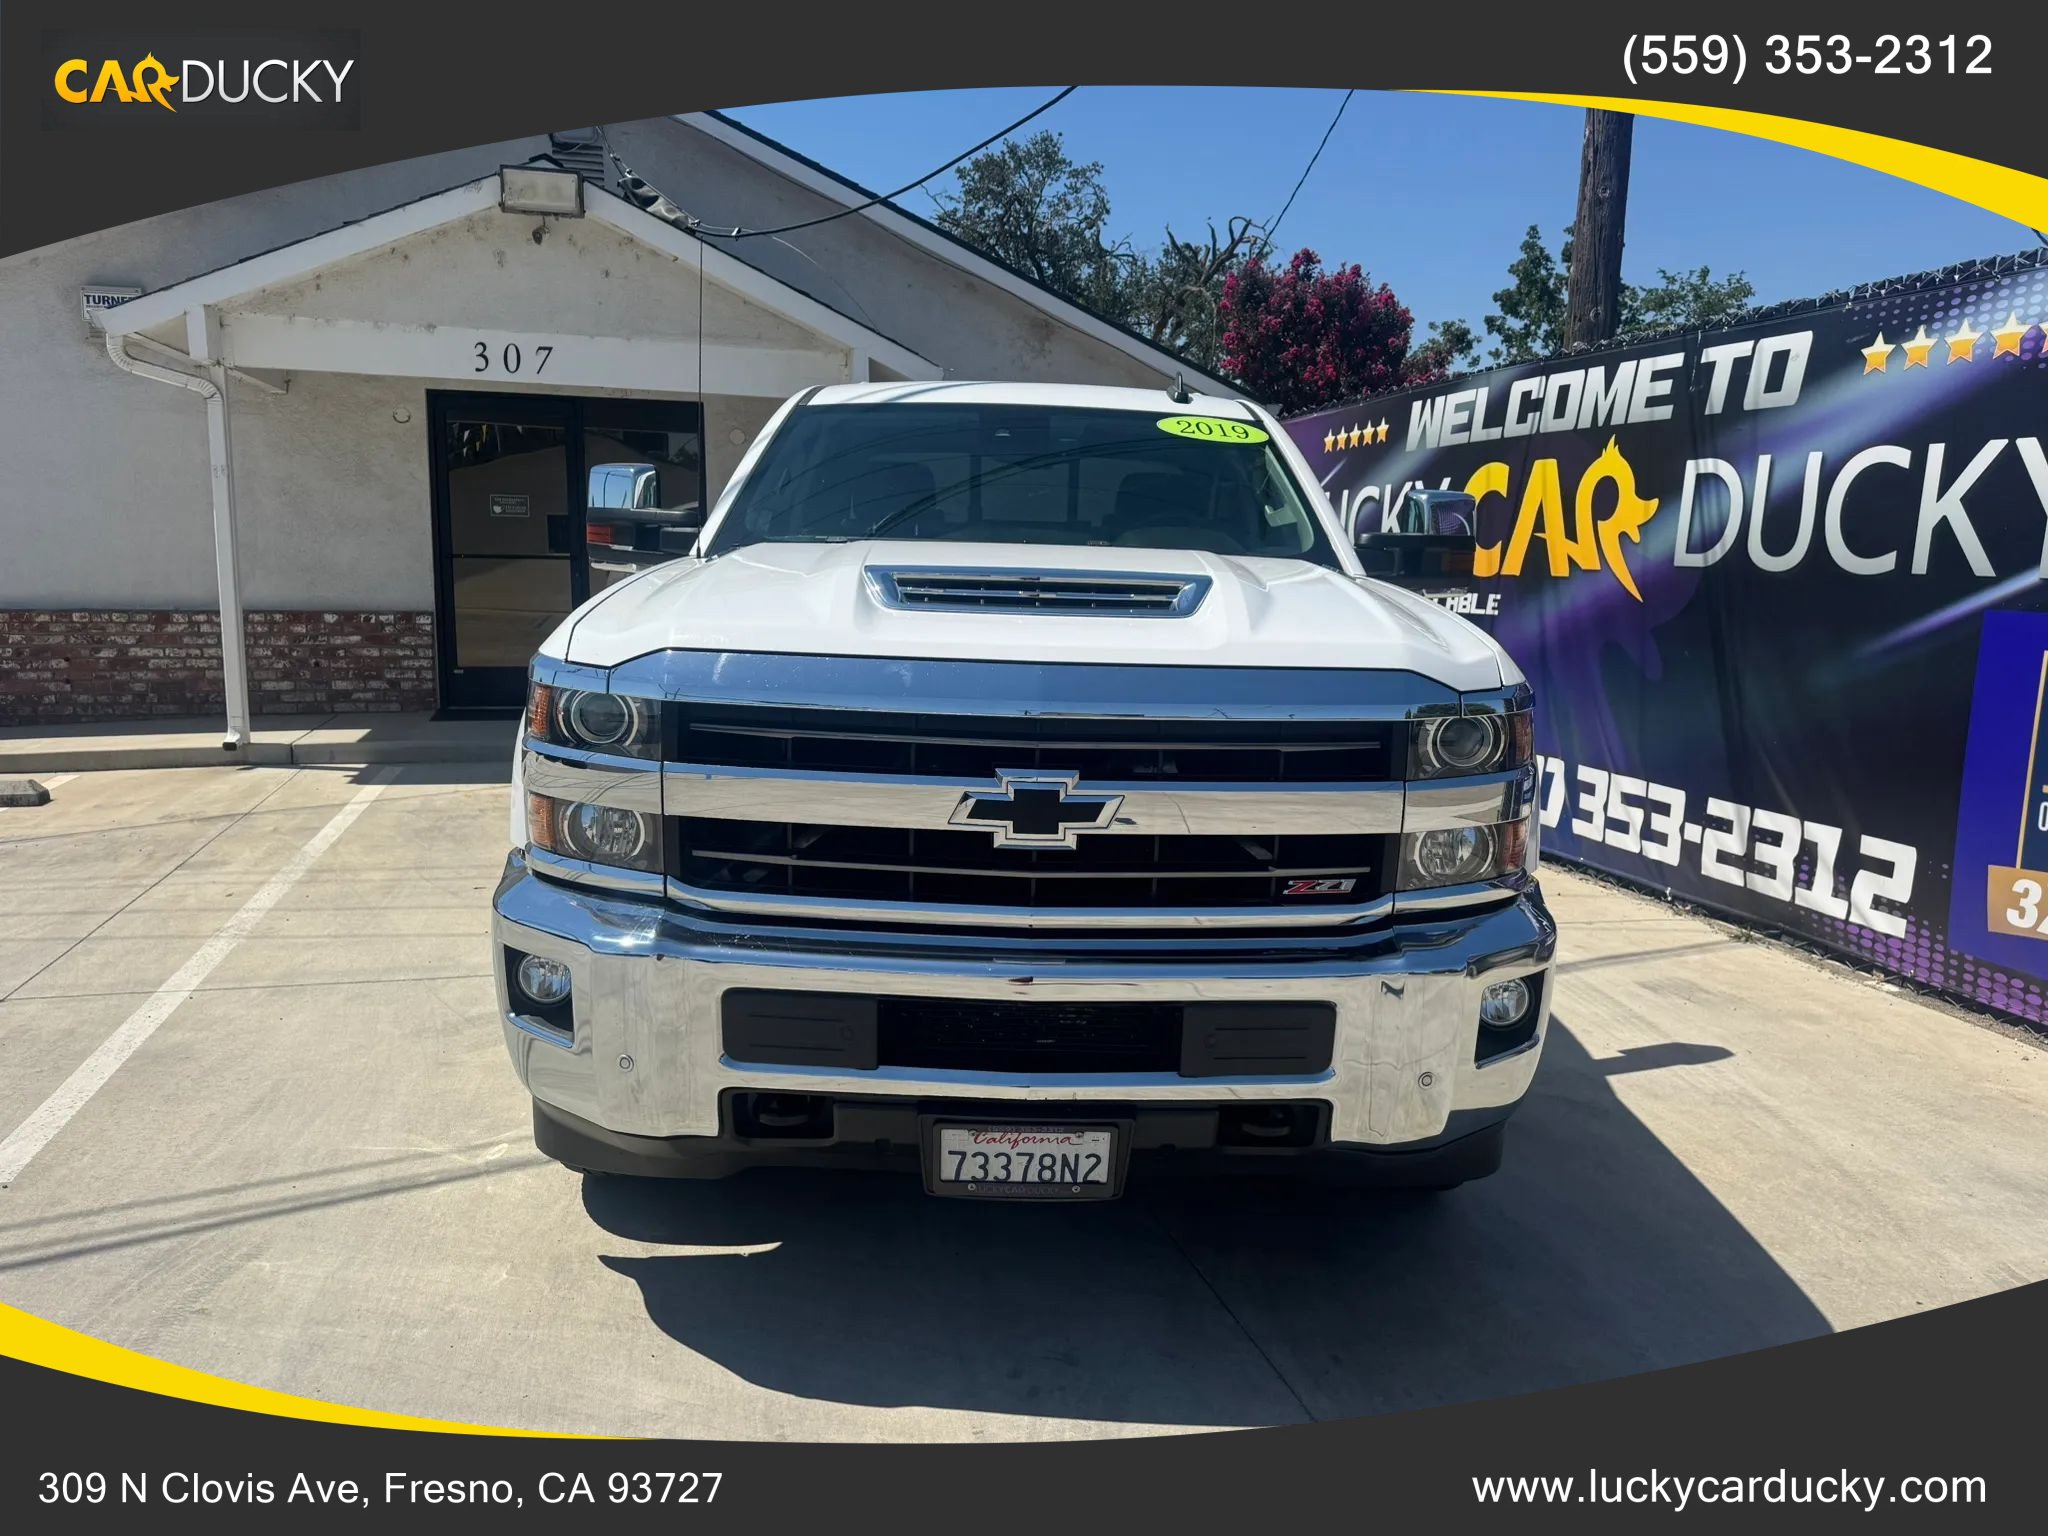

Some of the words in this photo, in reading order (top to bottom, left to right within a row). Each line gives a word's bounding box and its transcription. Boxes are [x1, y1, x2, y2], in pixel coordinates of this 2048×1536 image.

[84, 294, 133, 305] TURNE
[475, 342, 553, 374] 307
[1406, 352, 1685, 452] WELCOME
[1701, 330, 1813, 415] TO
[1176, 420, 1250, 440] 2019
[1464, 434, 1660, 603] CAR
[1572, 764, 1917, 938] 353-2312
[973, 1132, 1079, 1149] California
[948, 1150, 1102, 1183] 73378N2
